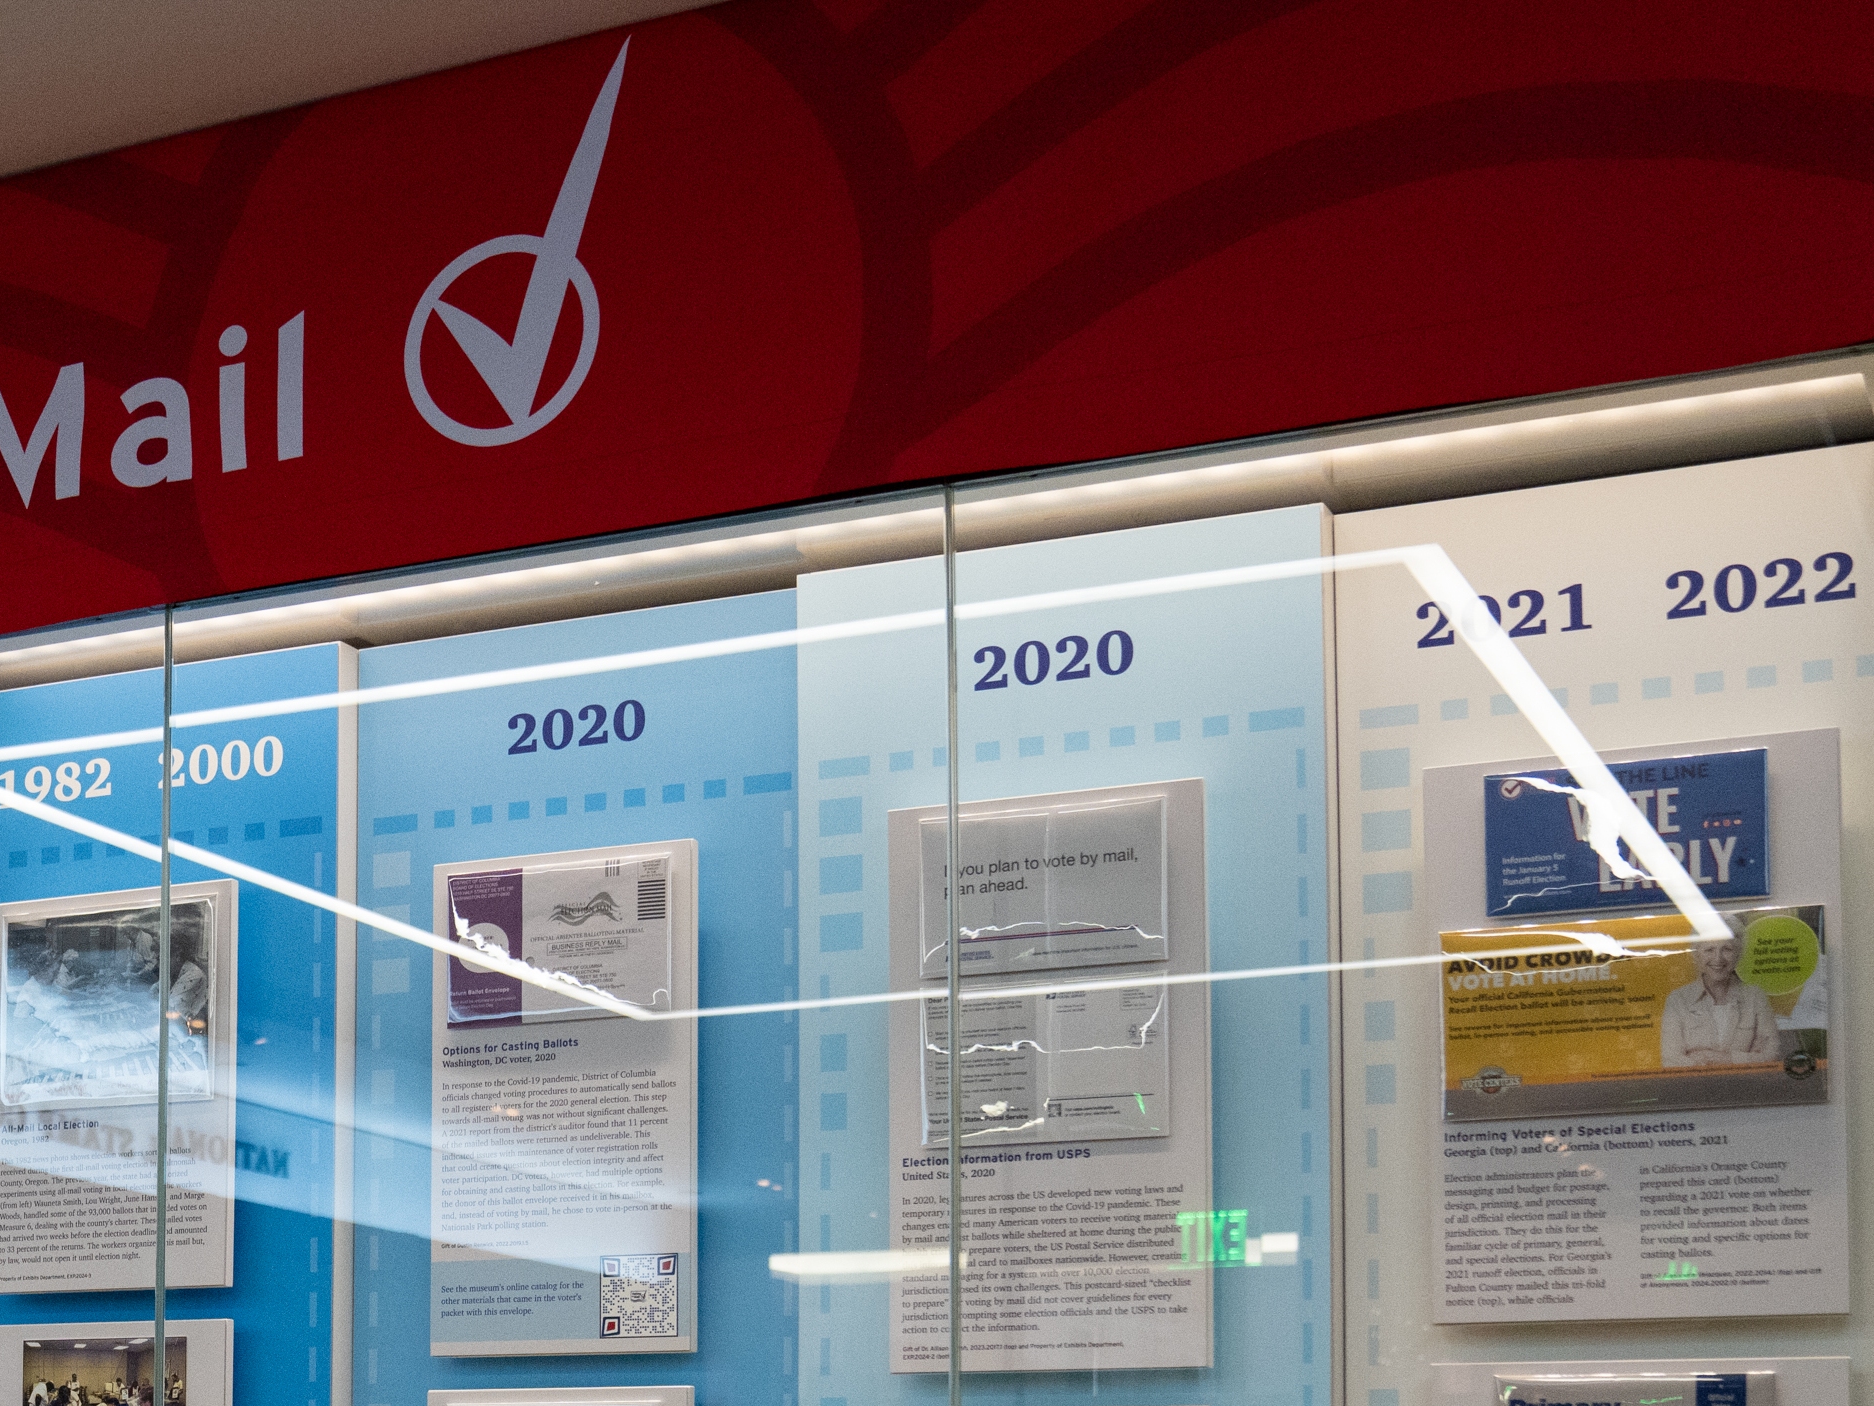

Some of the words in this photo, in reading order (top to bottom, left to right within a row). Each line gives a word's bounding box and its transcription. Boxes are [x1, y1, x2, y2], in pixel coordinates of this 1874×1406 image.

[1416, 584, 1592, 648] 2021
[1665, 552, 1856, 620] 2022
[974, 630, 1133, 691] 2020
[508, 700, 645, 755] 2020
[158, 736, 283, 789] 2000
[959, 864, 984, 879] you
[988, 860, 1019, 876] plan
[1024, 858, 1038, 870] to
[1043, 854, 1075, 868] vote
[1079, 851, 1098, 866] by
[1103, 848, 1138, 864] mail,
[979, 877, 1028, 892] ahead.
[552, 941, 583, 950] BUSINESS
[1448, 954, 1518, 974] AVOID
[1449, 972, 1506, 991] VOTE
[1512, 969, 1538, 986] AT
[1540, 963, 1618, 984] HOME.
[443, 1045, 480, 1056] Options
[484, 1044, 497, 1053] for
[501, 1041, 539, 1051] Casting
[543, 1038, 578, 1048] Ballots
[443, 1057, 492, 1068] Washington,
[495, 1057, 507, 1065] DC
[510, 1055, 532, 1064] voter,
[535, 1053, 556, 1062] 2020
[2, 1124, 35, 1134] All-Mail
[38, 1122, 61, 1132] Local
[63, 1119, 99, 1130] Election
[1444, 1129, 1507, 1144] Informing
[1512, 1127, 1555, 1140] Voters
[1560, 1126, 1573, 1137] of
[1577, 1124, 1625, 1140] Special
[1631, 1121, 1695, 1134] Elections
[902, 1156, 949, 1168] Election
[953, 1151, 1021, 1164] formation
[1025, 1150, 1053, 1161] from
[1057, 1148, 1091, 1160] USPS
